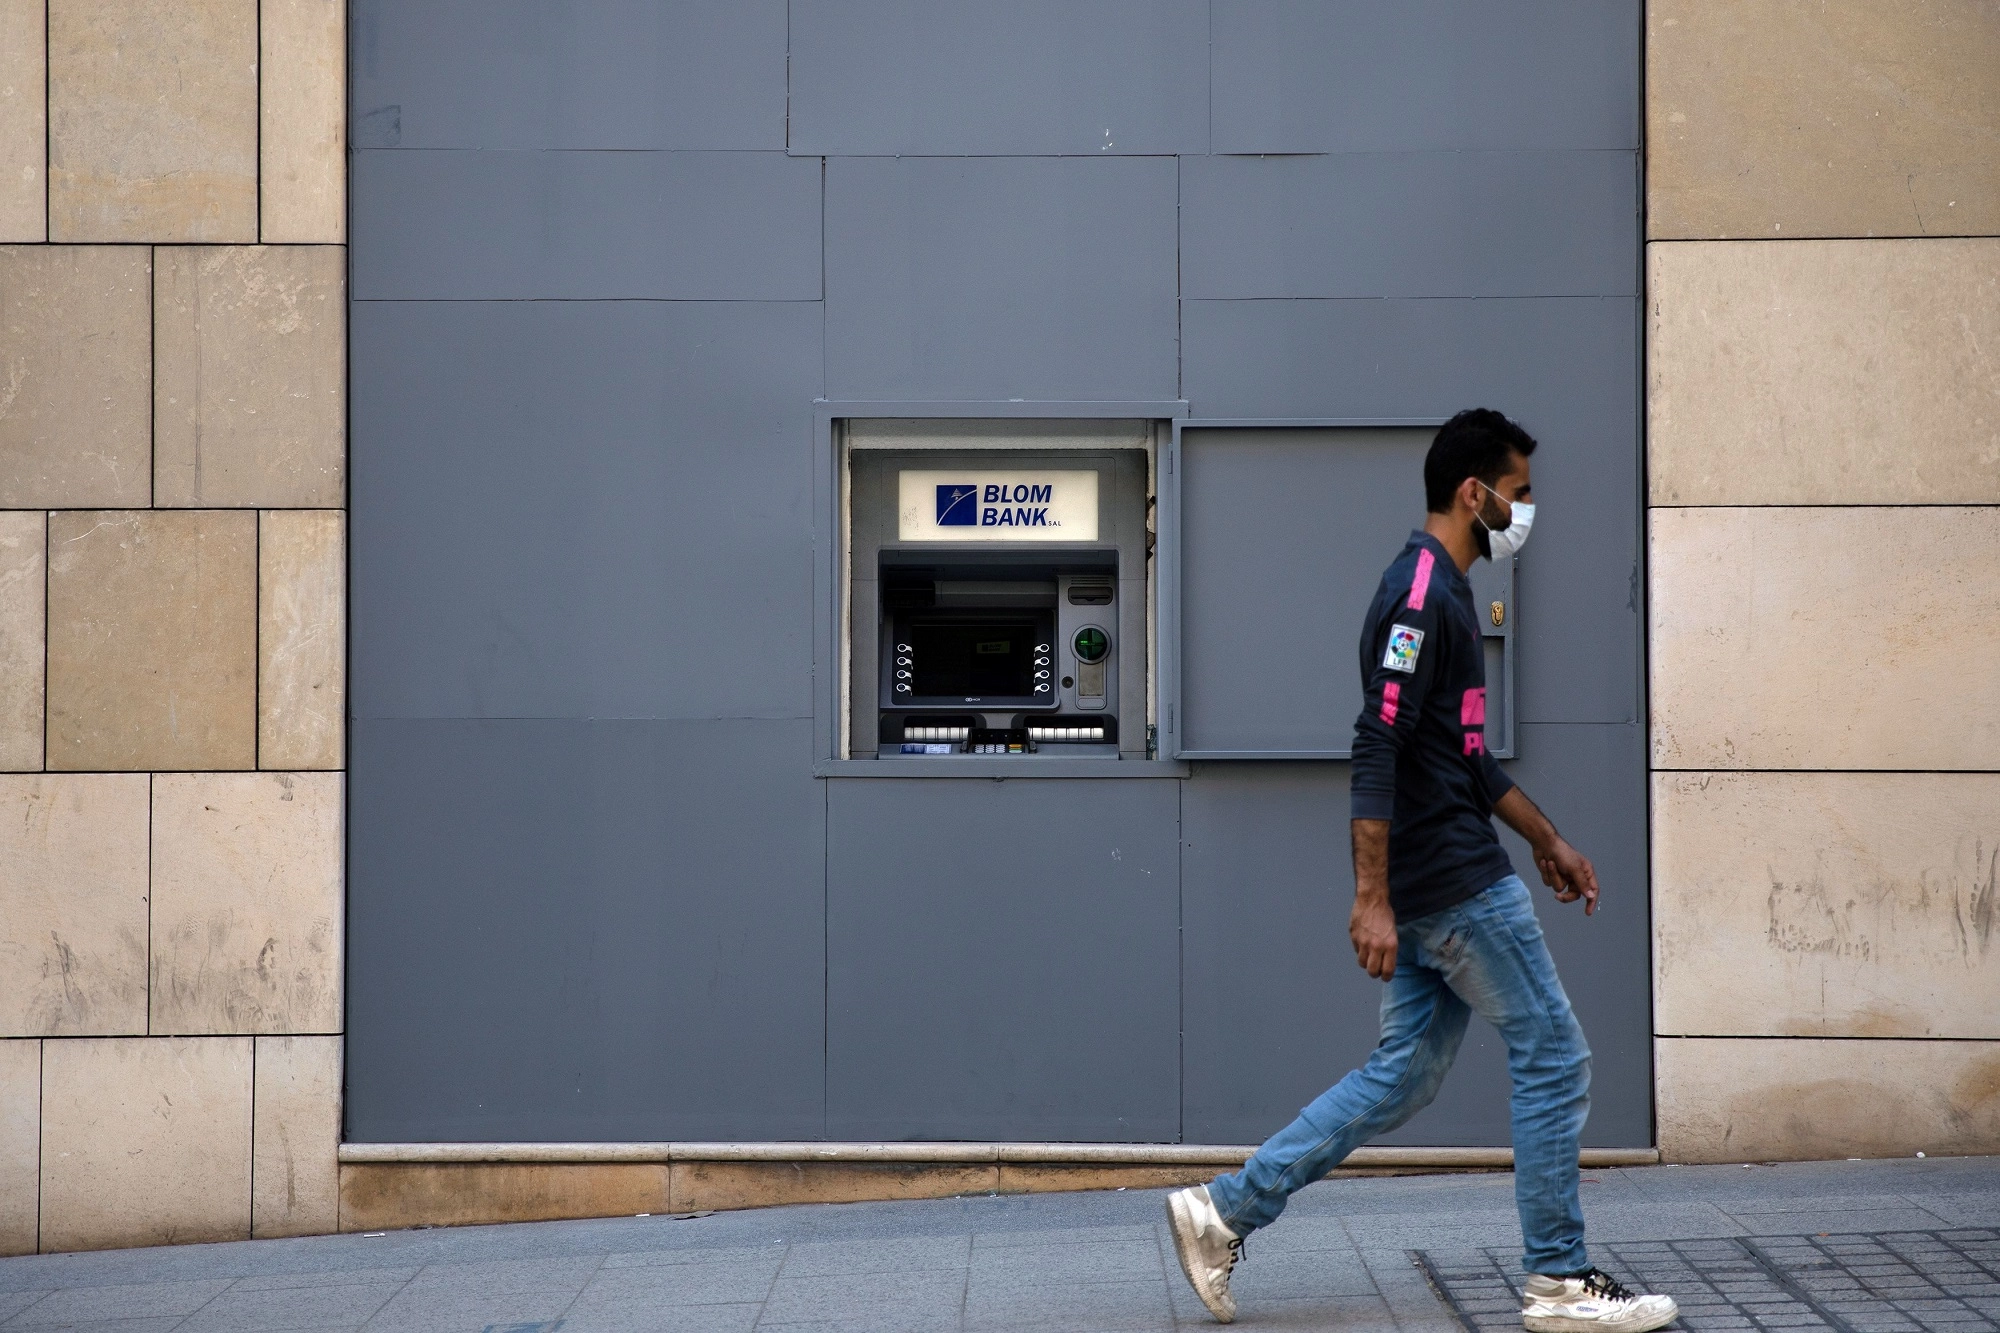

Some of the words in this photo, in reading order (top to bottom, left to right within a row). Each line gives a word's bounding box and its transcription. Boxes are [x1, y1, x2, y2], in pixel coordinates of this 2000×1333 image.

[983, 484, 1052, 503] BLOM
[981, 507, 1048, 526] BANK
[1393, 657, 1408, 666] LFP
